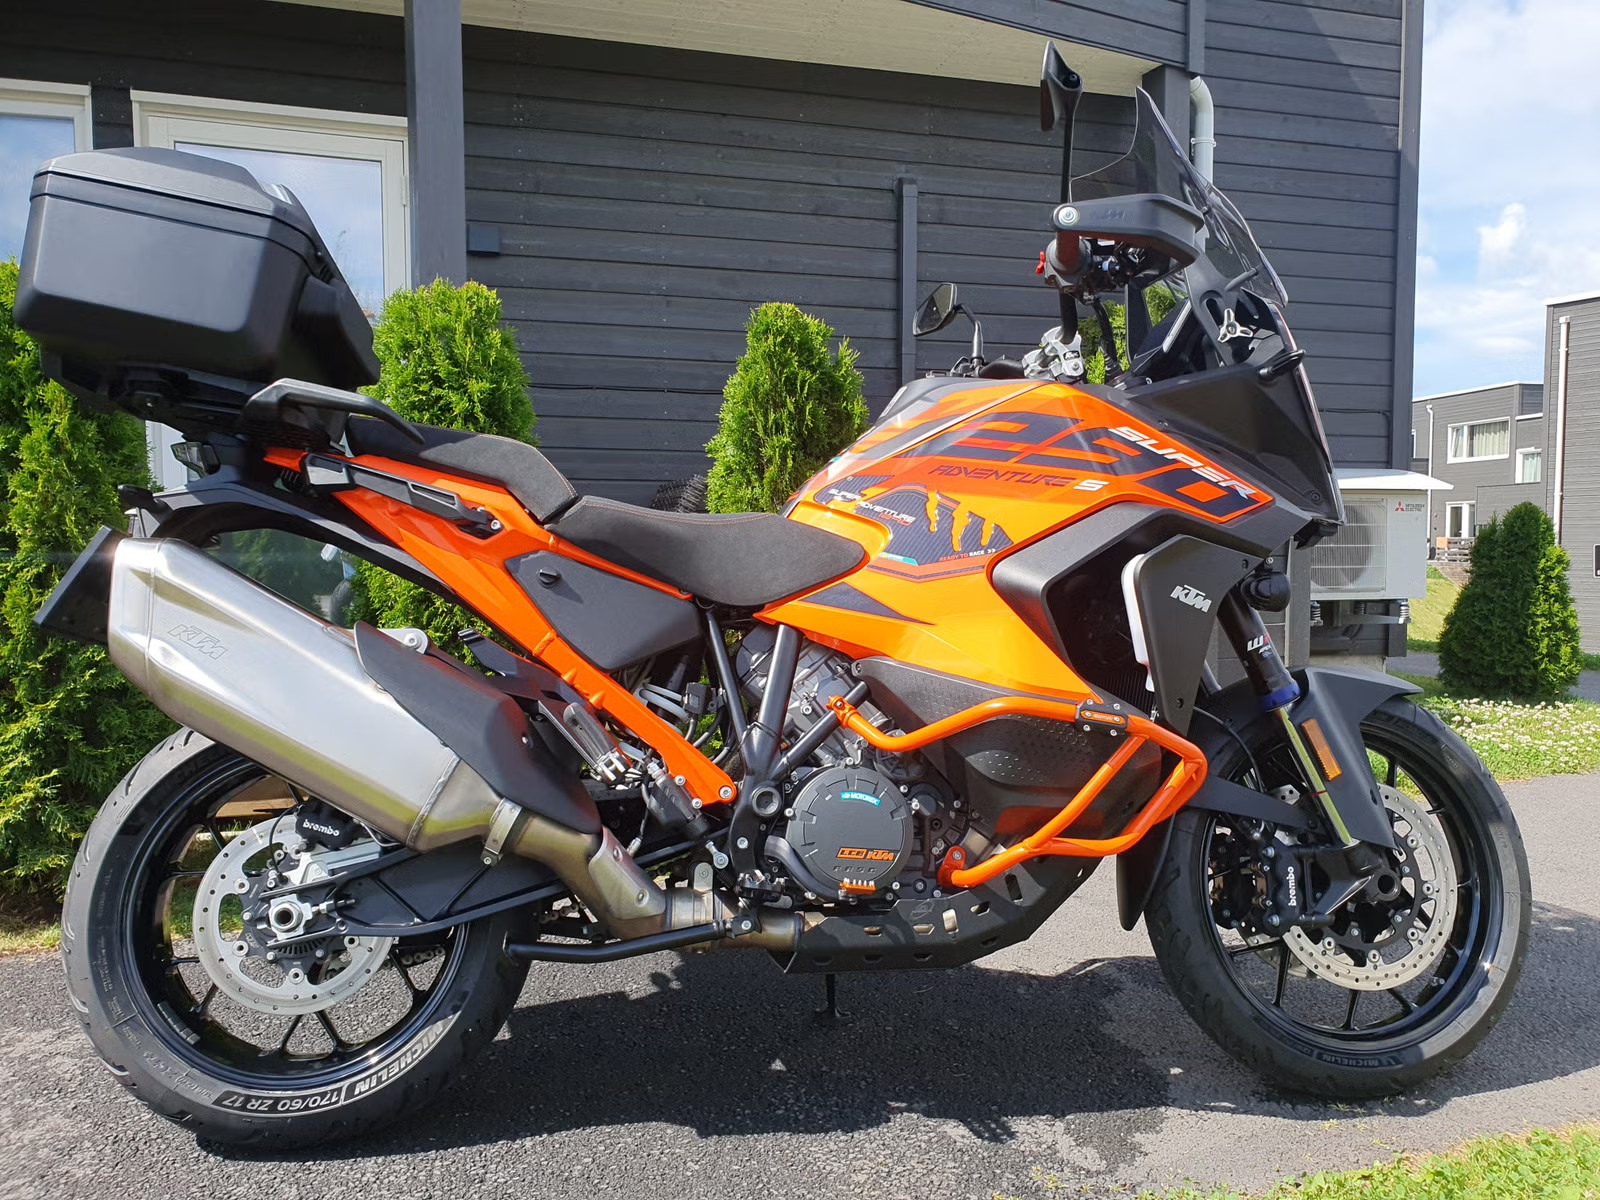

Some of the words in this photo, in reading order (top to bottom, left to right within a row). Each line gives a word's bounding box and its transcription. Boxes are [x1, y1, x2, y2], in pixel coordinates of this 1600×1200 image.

[1107, 426, 1257, 500] SUPER
[927, 464, 1077, 487] ADVENTURE
[1072, 479, 1110, 491] S
[828, 488, 862, 500] SUPER
[855, 500, 917, 523] ADVENTURE
[969, 549, 985, 557] RACE
[1170, 584, 1212, 613] KTM
[166, 623, 228, 660] KTM
[302, 818, 340, 837] brembo
[866, 849, 895, 861] KTM
[1285, 865, 1297, 906] brembo
[353, 1022, 445, 1096] MICHELIN
[1321, 1053, 1380, 1067] MICHELIN
[222, 1094, 243, 1108] 17
[246, 1098, 272, 1112] ZR
[277, 1091, 340, 1112] 170/60
